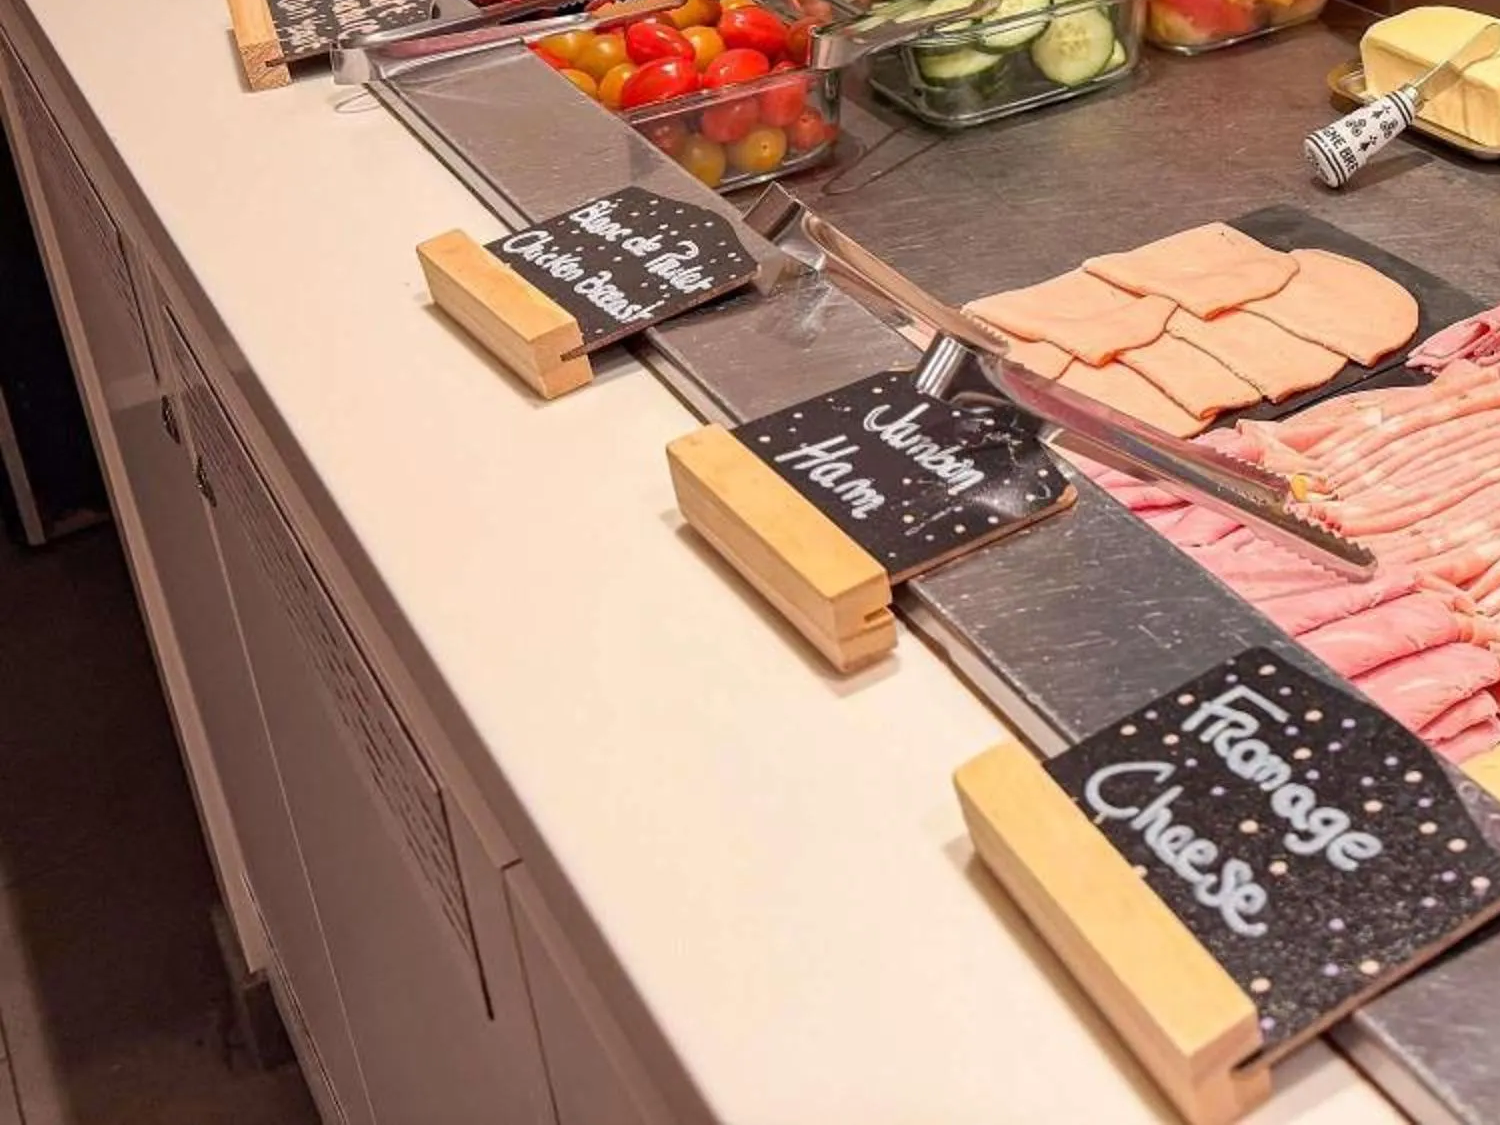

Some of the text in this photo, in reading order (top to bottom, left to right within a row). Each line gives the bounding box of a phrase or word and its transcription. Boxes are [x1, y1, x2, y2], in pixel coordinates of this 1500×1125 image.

[503, 230, 584, 281] Chicken
[774, 435, 886, 520] Ham
[863, 402, 985, 495] Jambon
[1085, 760, 1268, 937] Cheese
